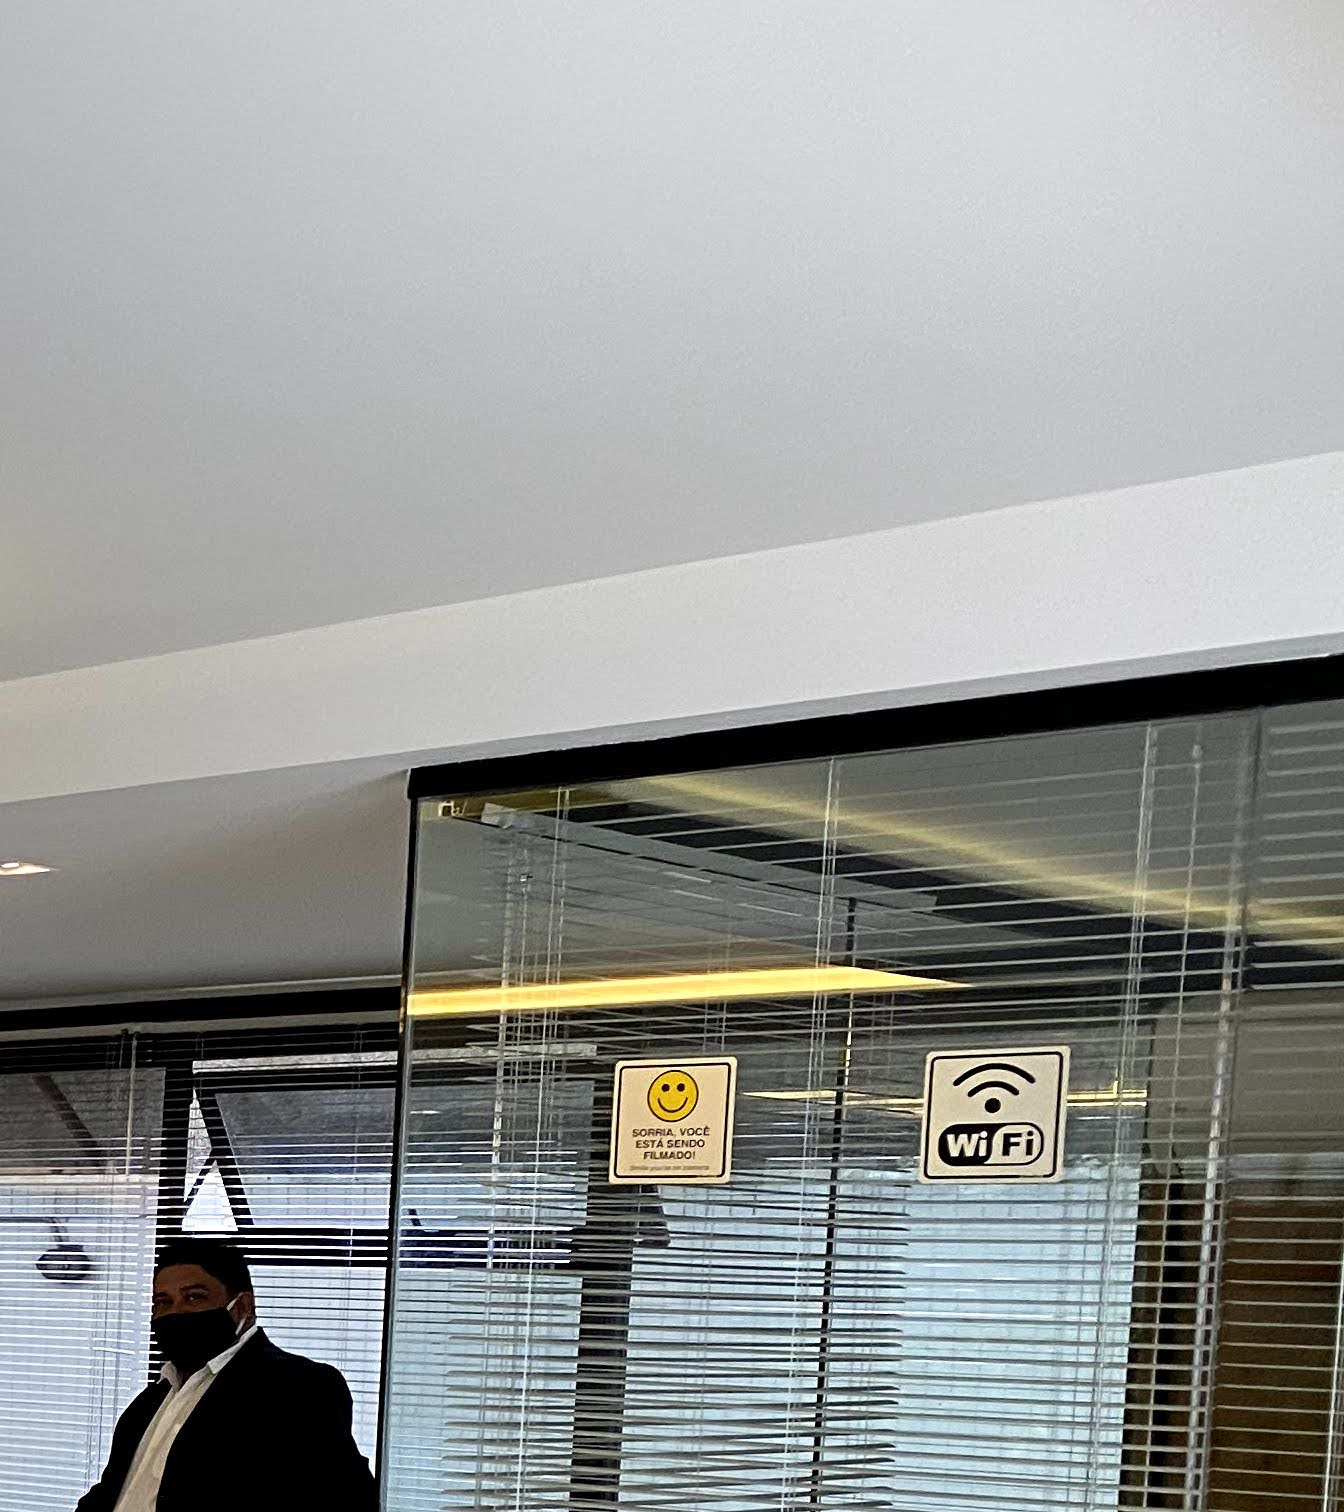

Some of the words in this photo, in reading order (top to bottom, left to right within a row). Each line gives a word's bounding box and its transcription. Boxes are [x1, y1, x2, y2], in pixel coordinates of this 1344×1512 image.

[632, 1128, 677, 1138] SORRIA,
[679, 1126, 710, 1136] VOCÊ
[635, 1138, 664, 1149] ESTÁ
[666, 1139, 705, 1148] SENDO
[643, 1150, 696, 1160] FILMADO!
